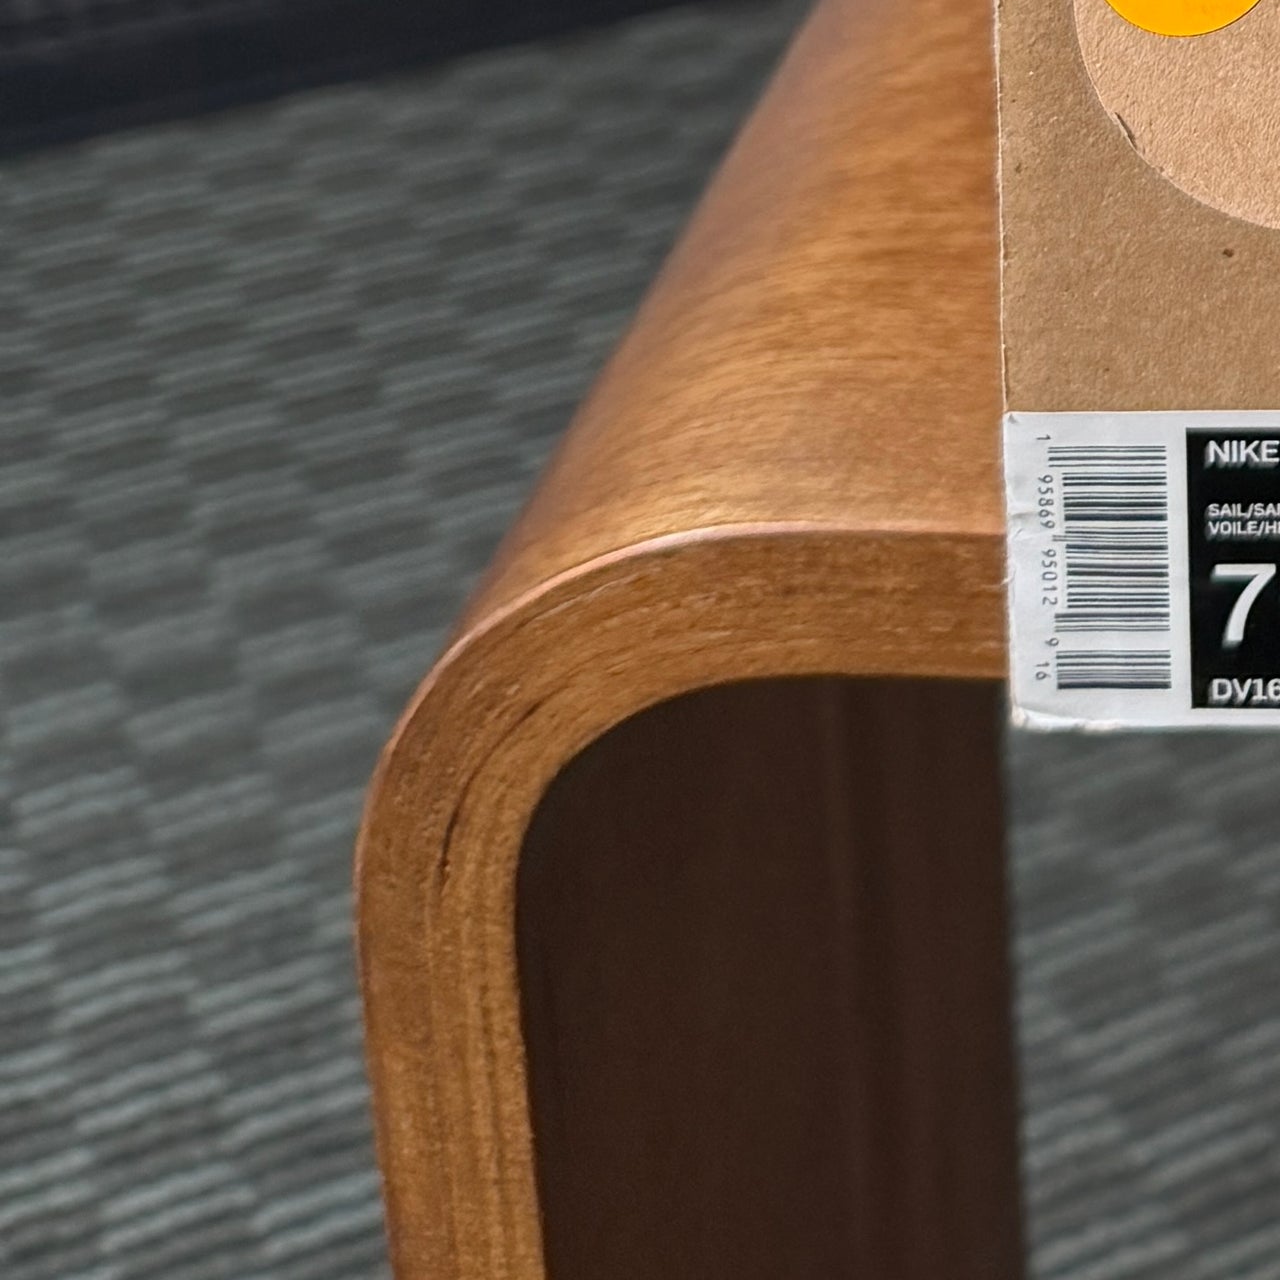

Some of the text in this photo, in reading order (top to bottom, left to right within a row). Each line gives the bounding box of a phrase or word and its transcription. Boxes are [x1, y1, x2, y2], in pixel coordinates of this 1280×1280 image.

[1206, 439, 1280, 466] NIKE
[1037, 474, 1056, 529] 95869
[1041, 548, 1059, 607] 95012
